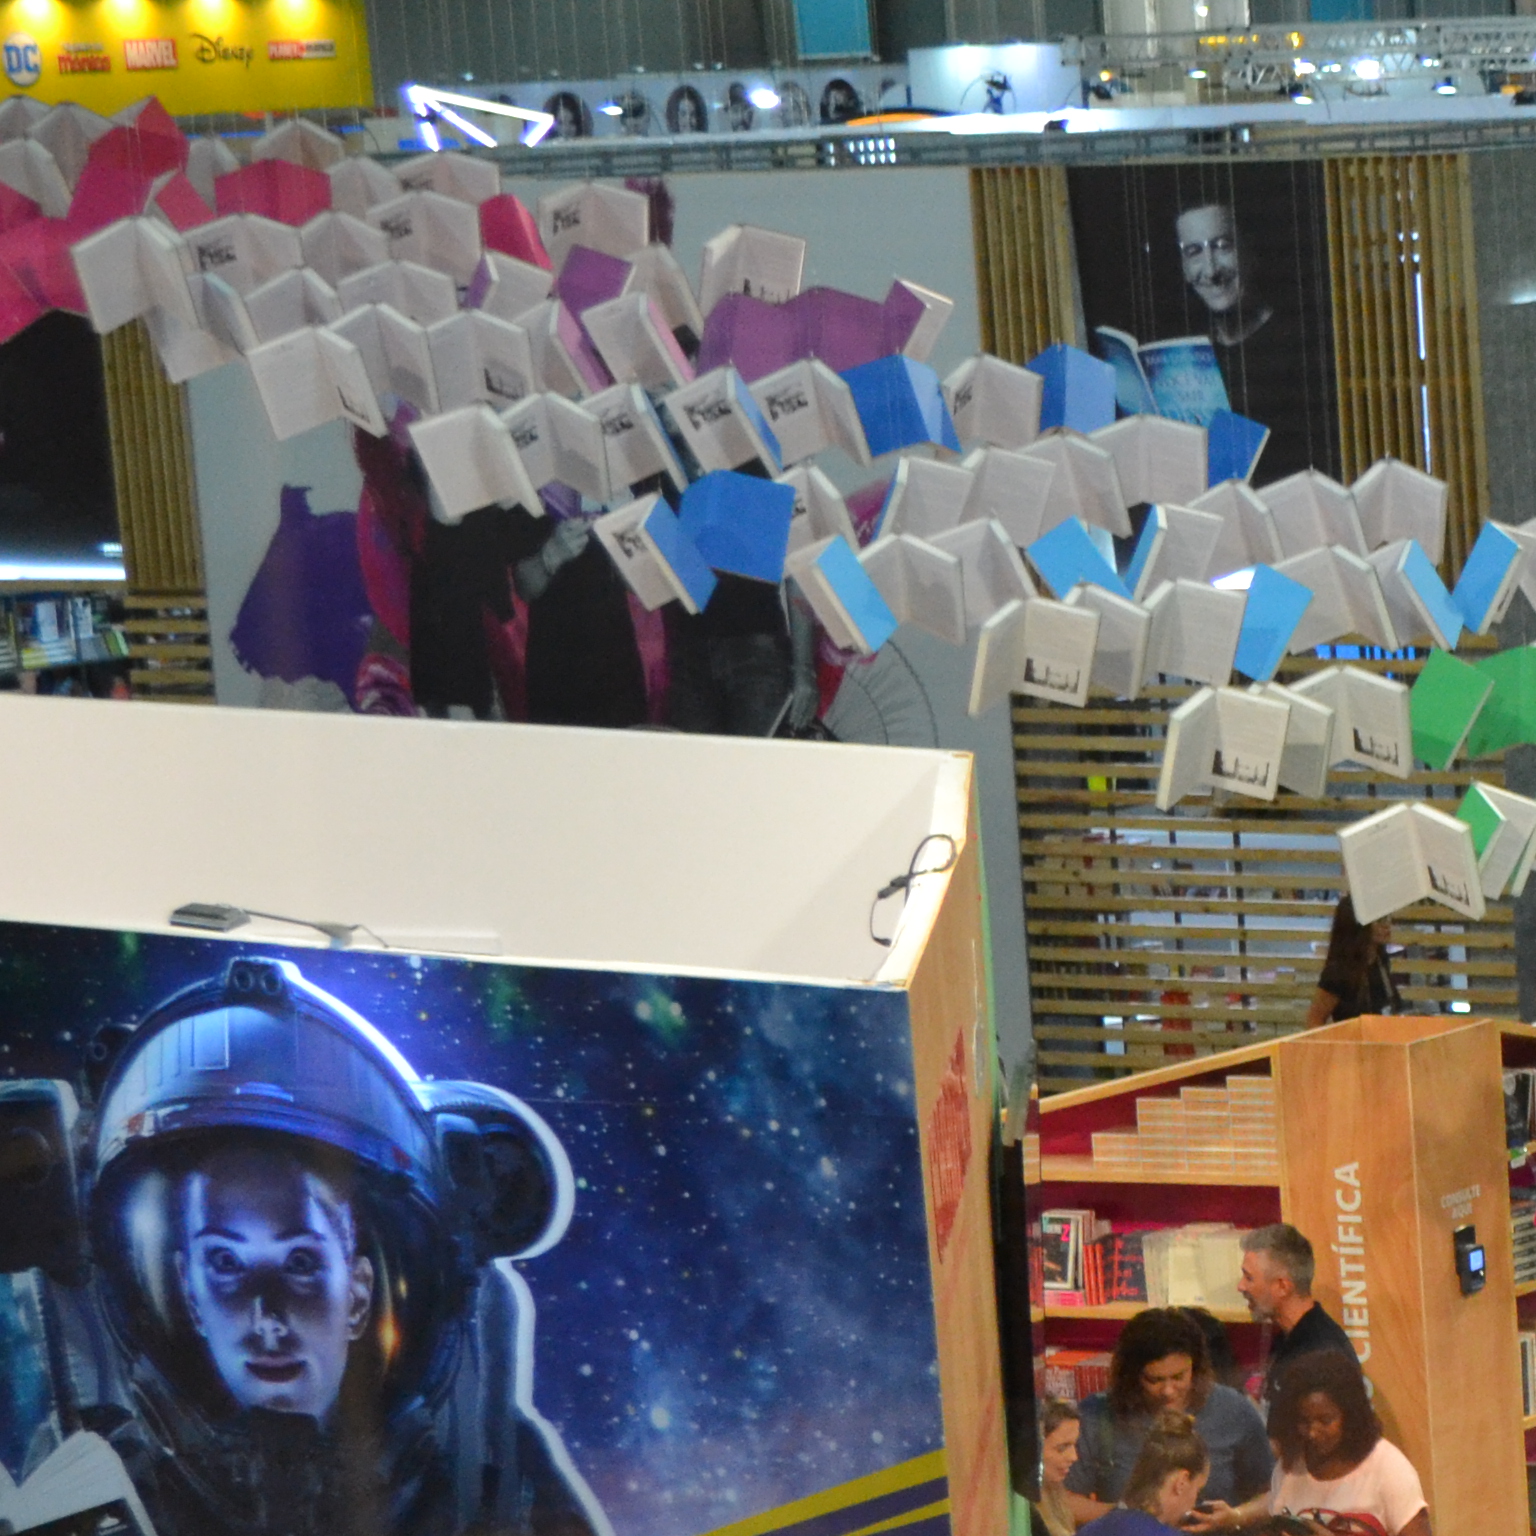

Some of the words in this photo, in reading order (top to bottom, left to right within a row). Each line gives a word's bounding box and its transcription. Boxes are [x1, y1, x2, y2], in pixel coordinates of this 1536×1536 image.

[4, 44, 39, 74] DC
[126, 41, 178, 70] MARVEL
[190, 33, 254, 68] Disney
[1331, 1161, 1371, 1364] CIENTÍFICA
